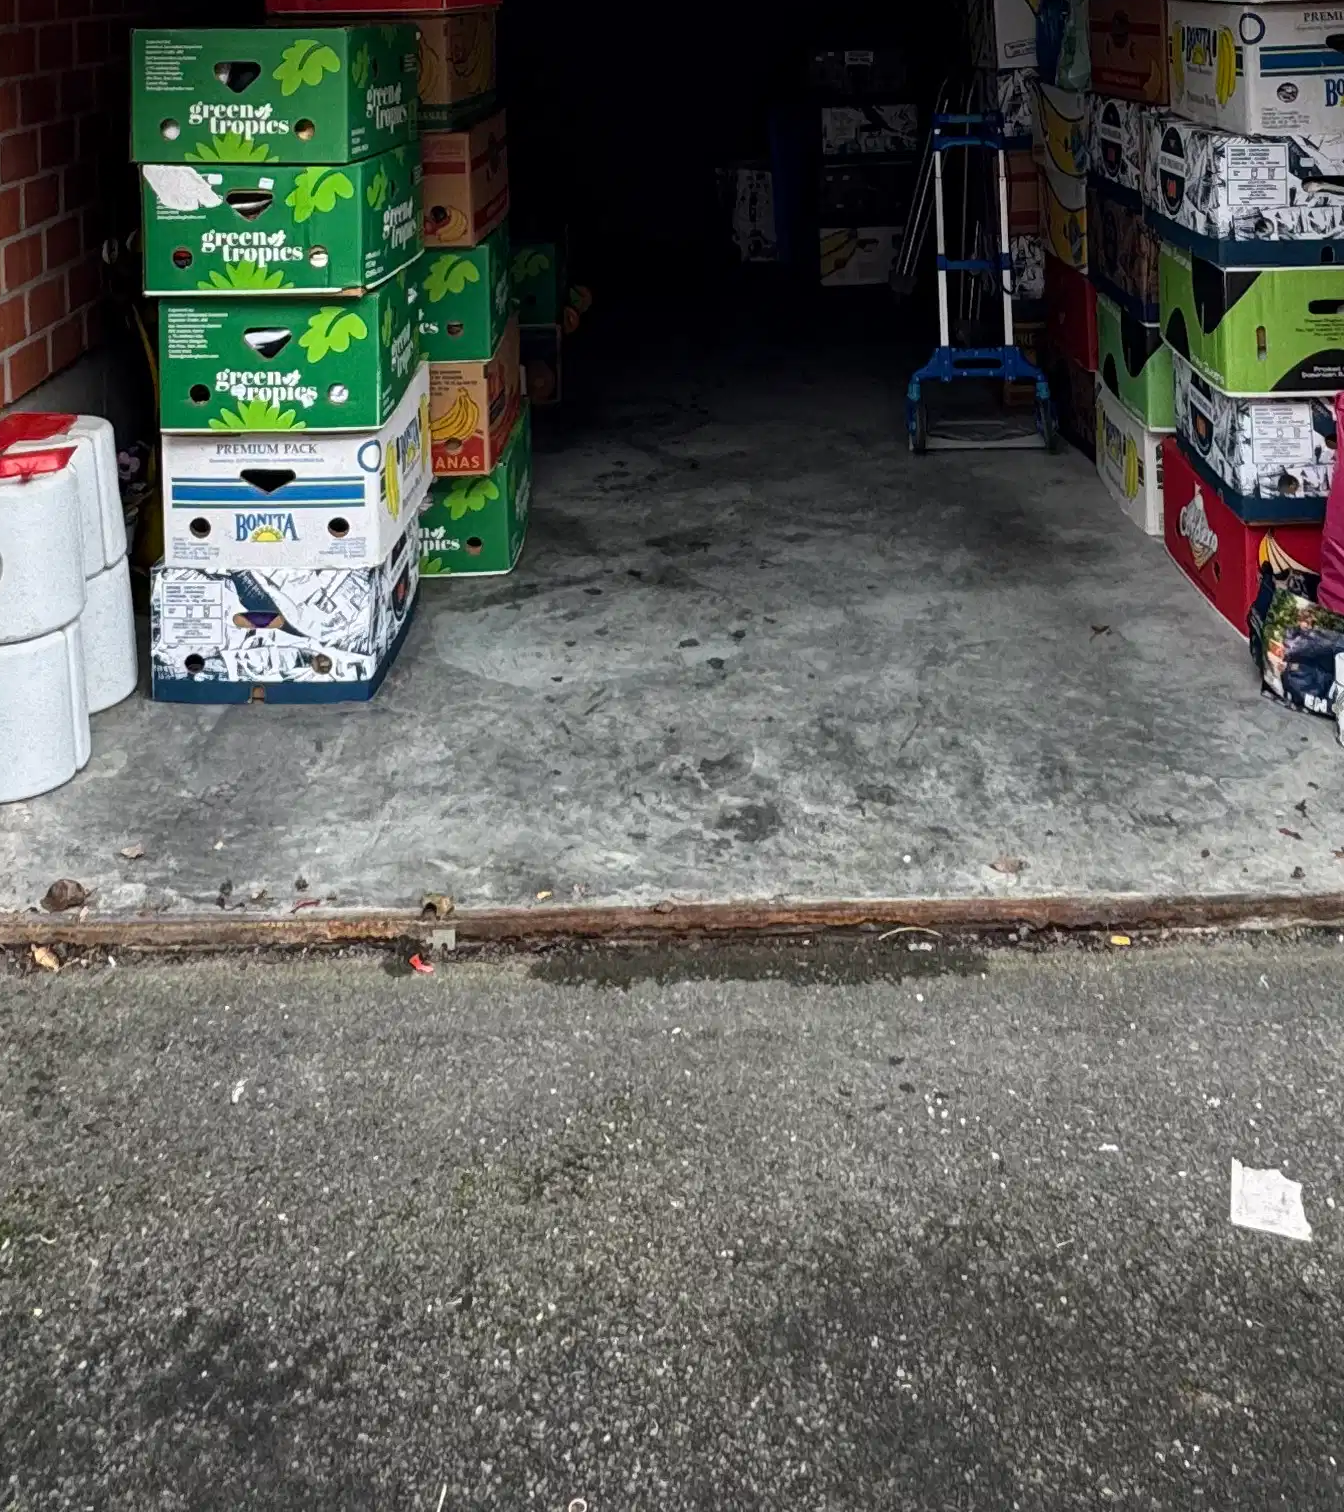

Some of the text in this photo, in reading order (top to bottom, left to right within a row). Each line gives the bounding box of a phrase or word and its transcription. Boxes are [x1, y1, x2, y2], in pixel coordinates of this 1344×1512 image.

[188, 101, 256, 125] green
[210, 113, 290, 141] tropics
[201, 229, 268, 253] green
[222, 242, 304, 268] tropics
[215, 368, 283, 392] green
[216, 443, 318, 455] PREMIUM PACK
[434, 455, 480, 470] ANAS
[234, 513, 301, 543] BONITA
[418, 537, 461, 557] pics
